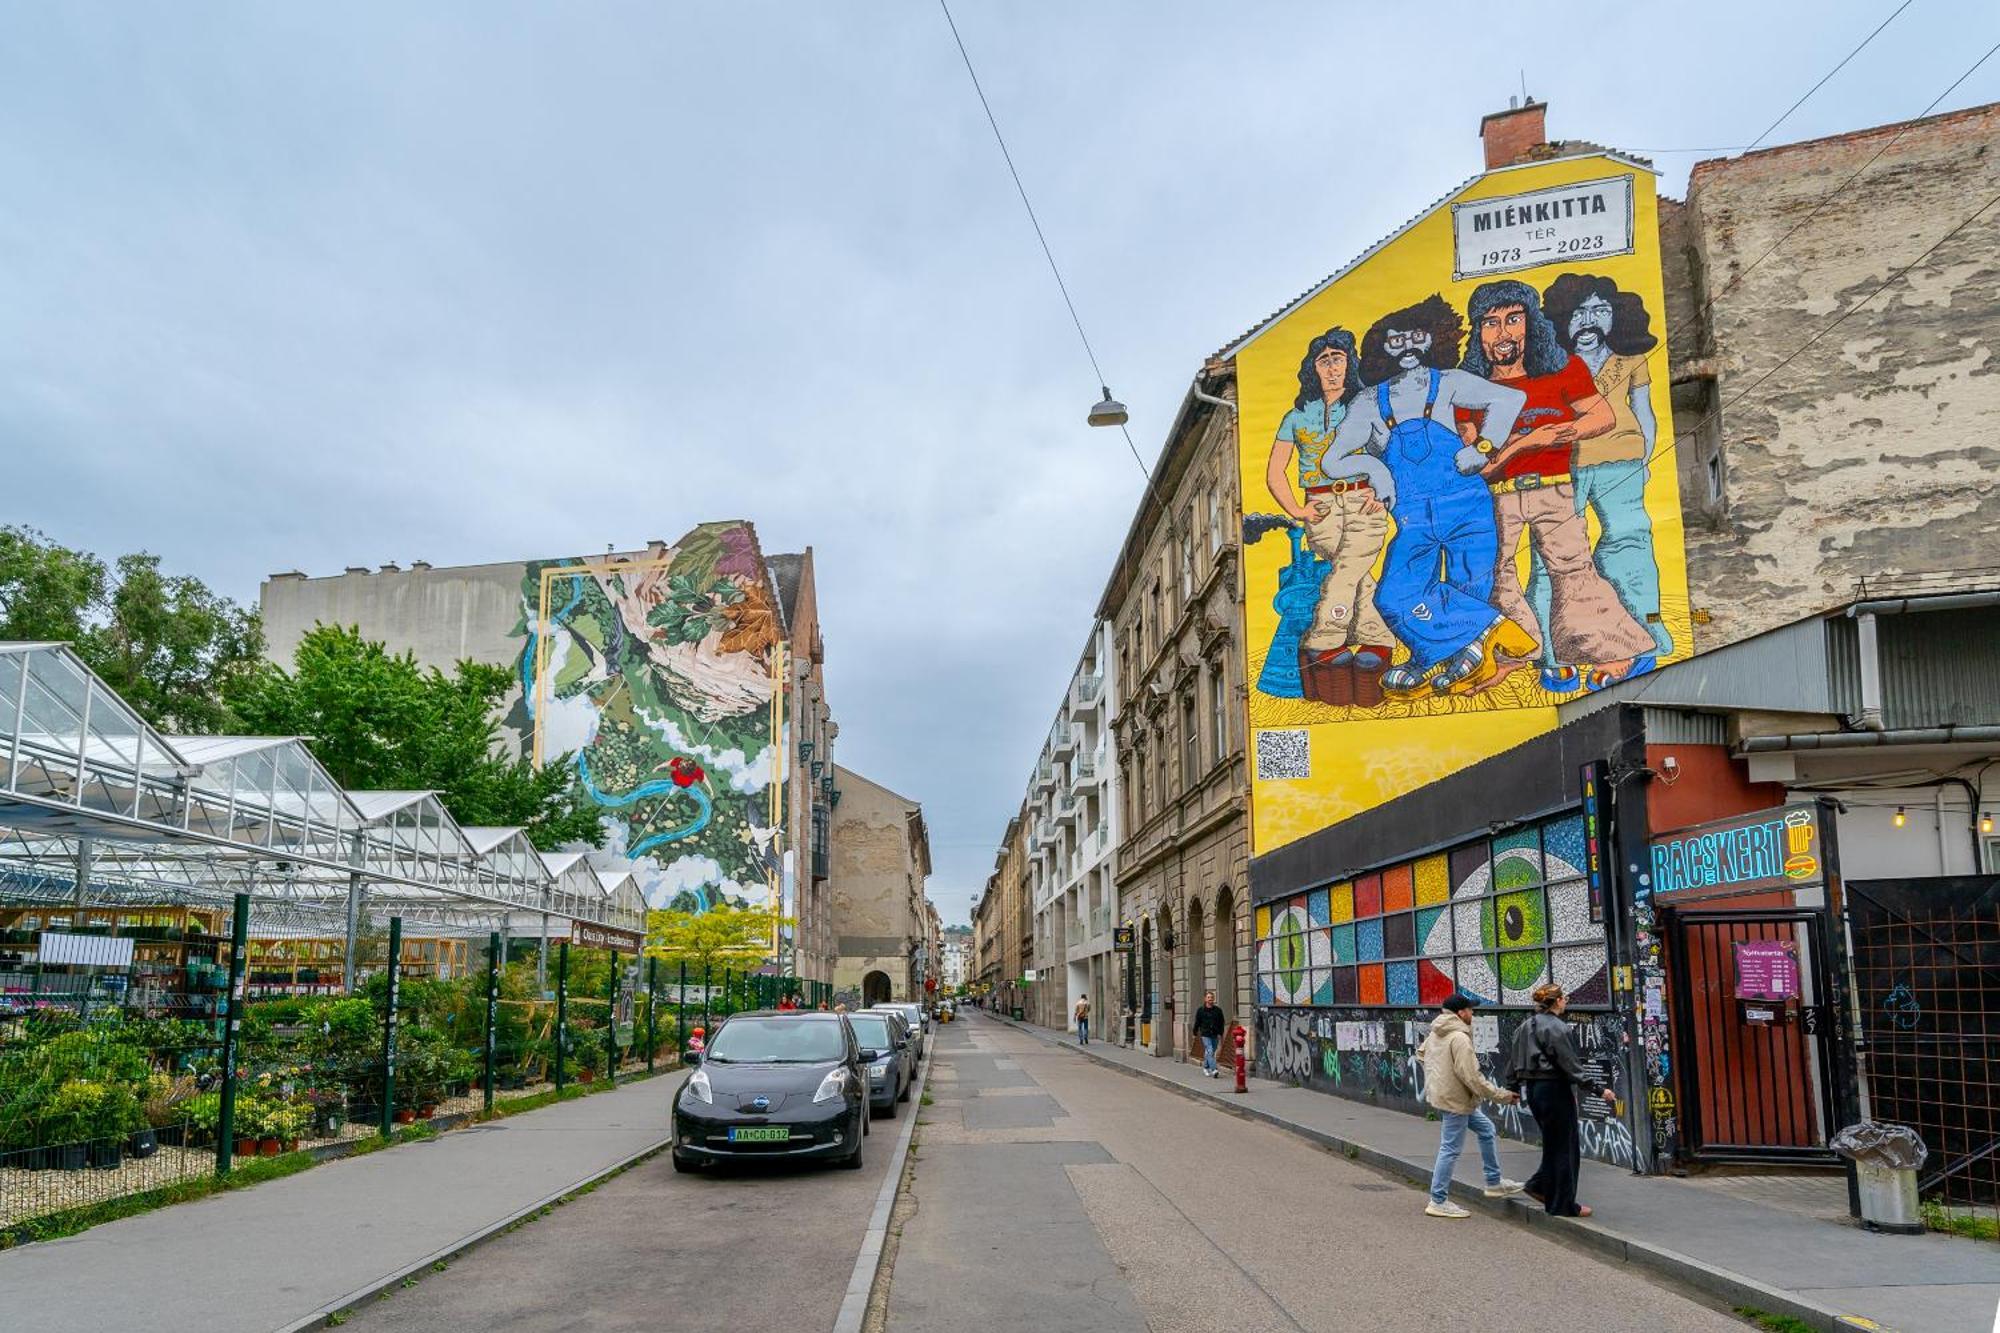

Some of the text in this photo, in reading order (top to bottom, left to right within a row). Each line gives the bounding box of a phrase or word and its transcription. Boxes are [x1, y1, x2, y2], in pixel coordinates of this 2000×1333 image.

[1474, 194, 1606, 232] MIÉNKITTA
[1525, 227, 1556, 241] TÉR
[1481, 235, 1604, 266] 1973 2023
